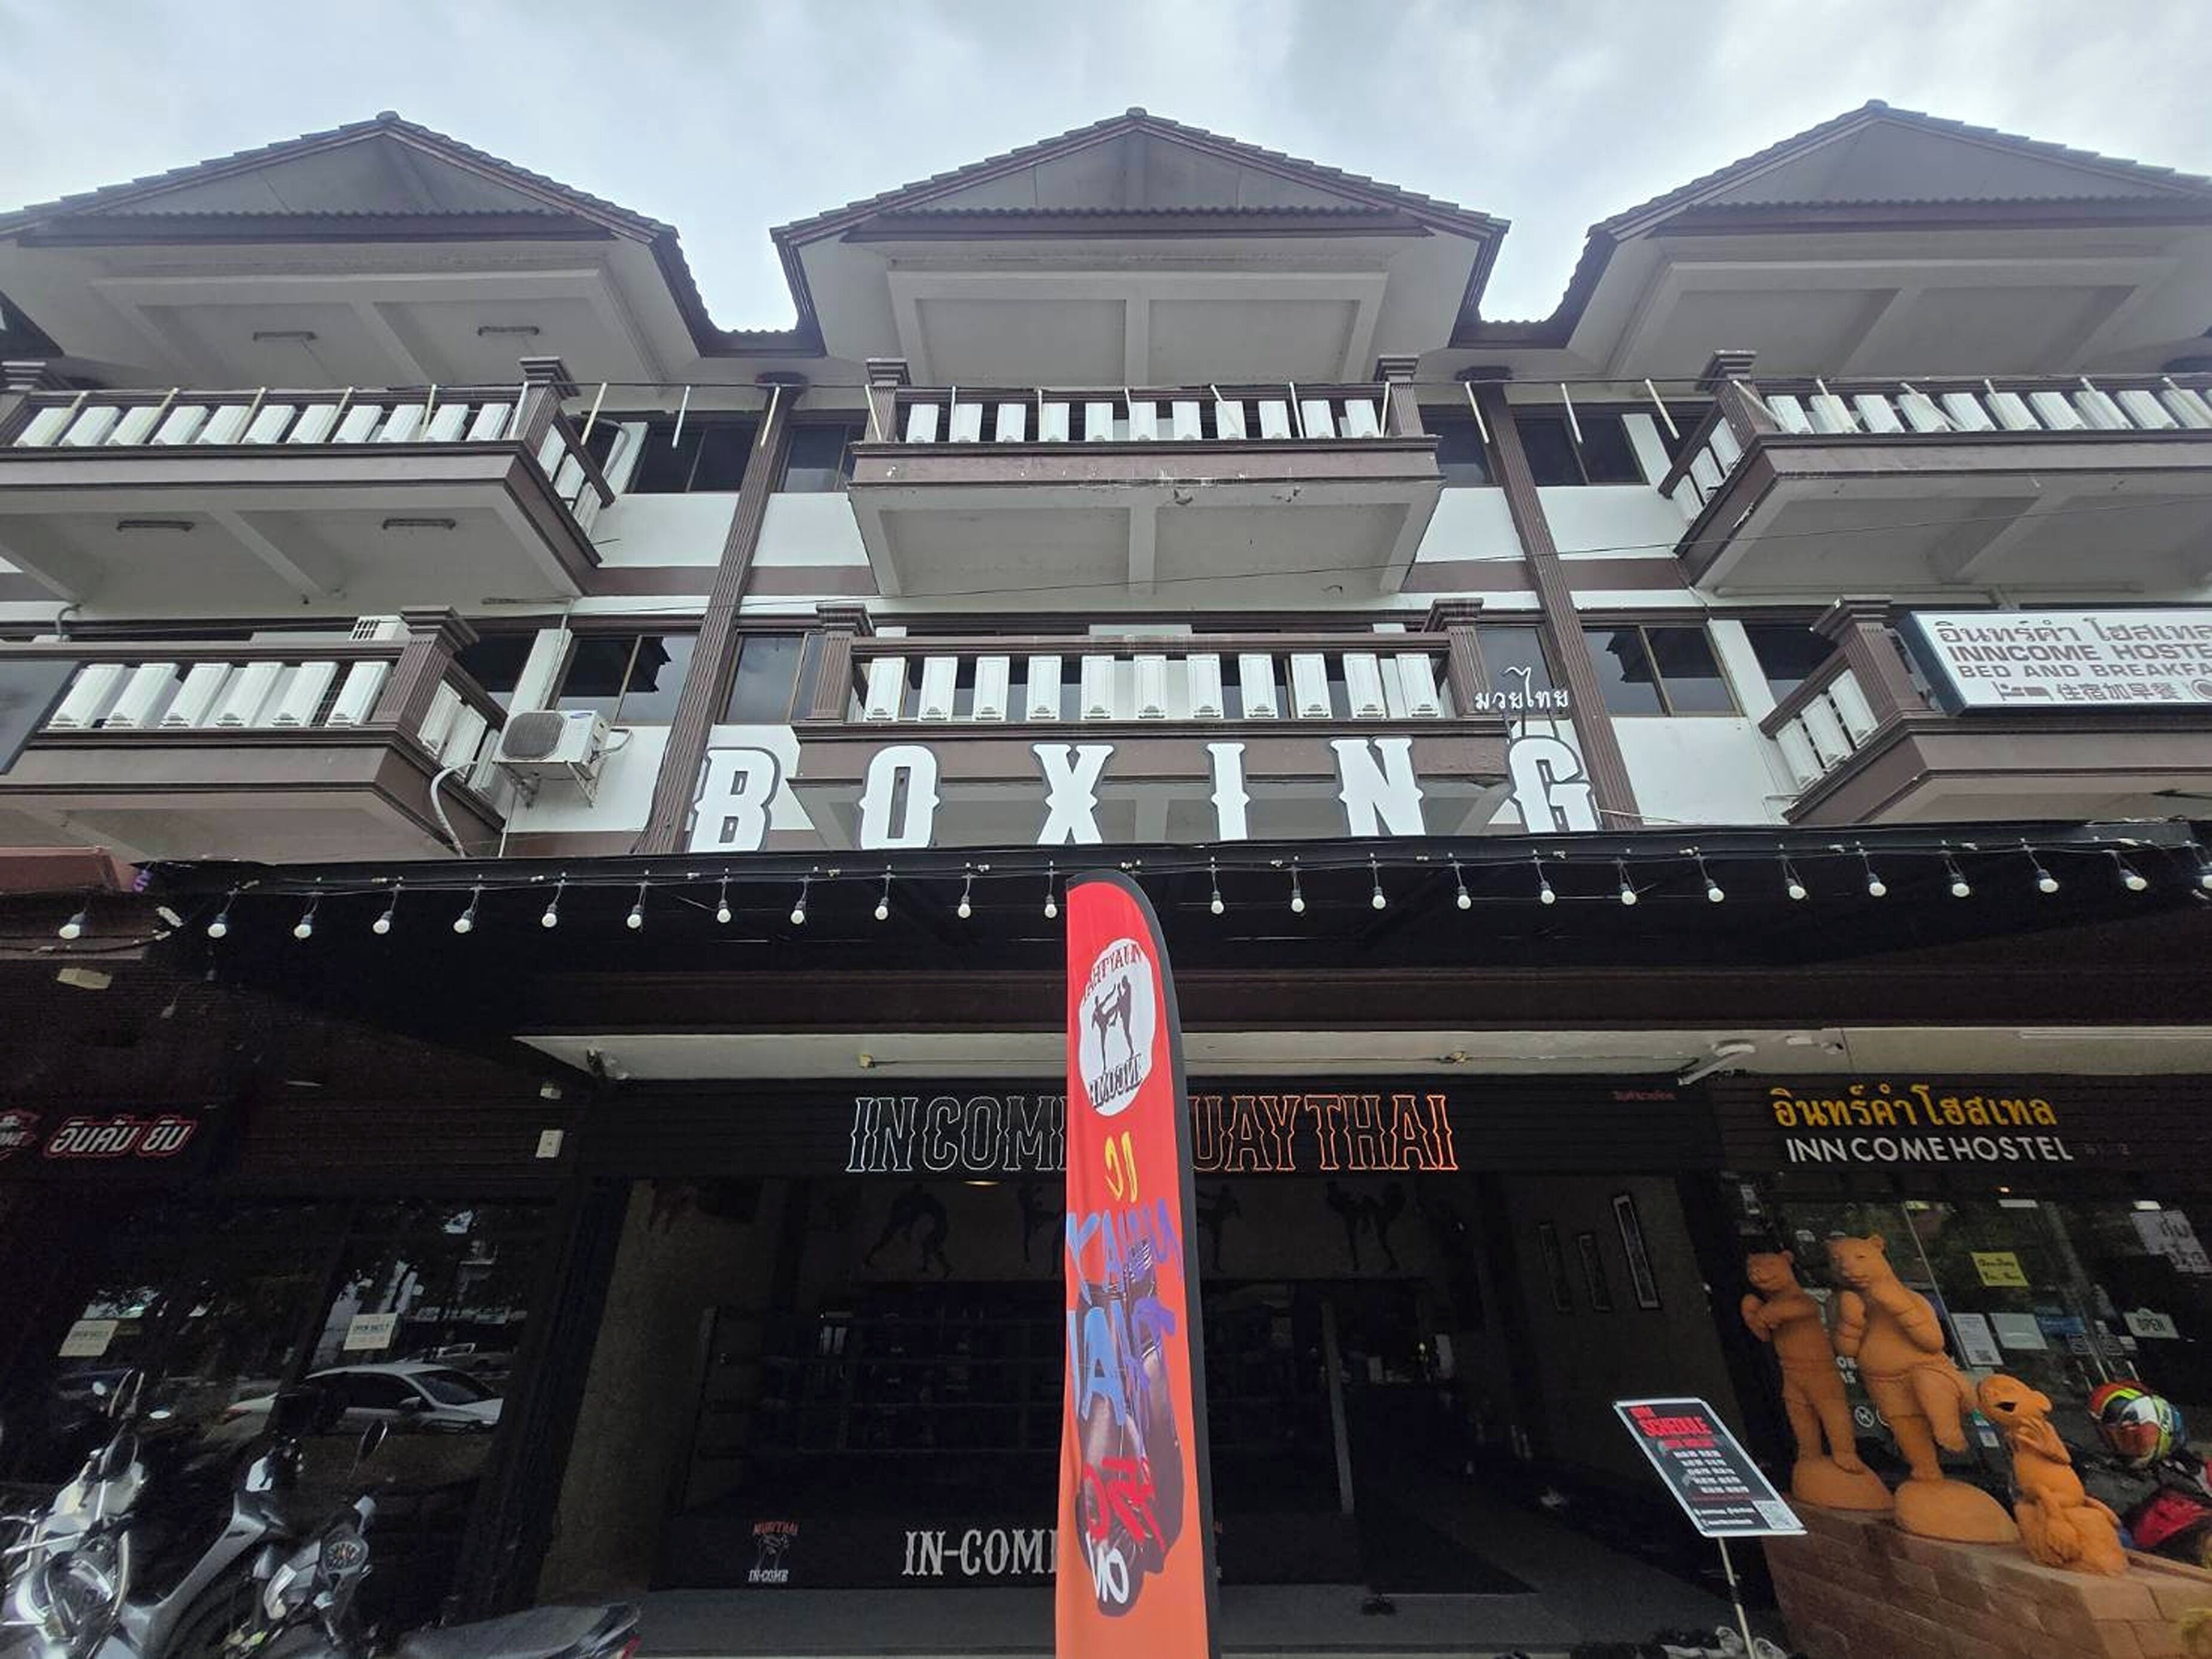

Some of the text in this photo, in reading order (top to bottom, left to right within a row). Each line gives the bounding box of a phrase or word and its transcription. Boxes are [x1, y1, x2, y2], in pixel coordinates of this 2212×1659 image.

[1947, 645, 2102, 661] INNCOME
[1958, 665, 2011, 678] BED
[2024, 664, 2081, 677] AND
[1474, 666, 1569, 710] มวยไทย
[689, 737, 1598, 853] BOXING
[1910, 1083, 2058, 1125] โฮสเทล
[845, 1095, 1067, 1172] INCOM
[1187, 1094, 1301, 1171] UAY
